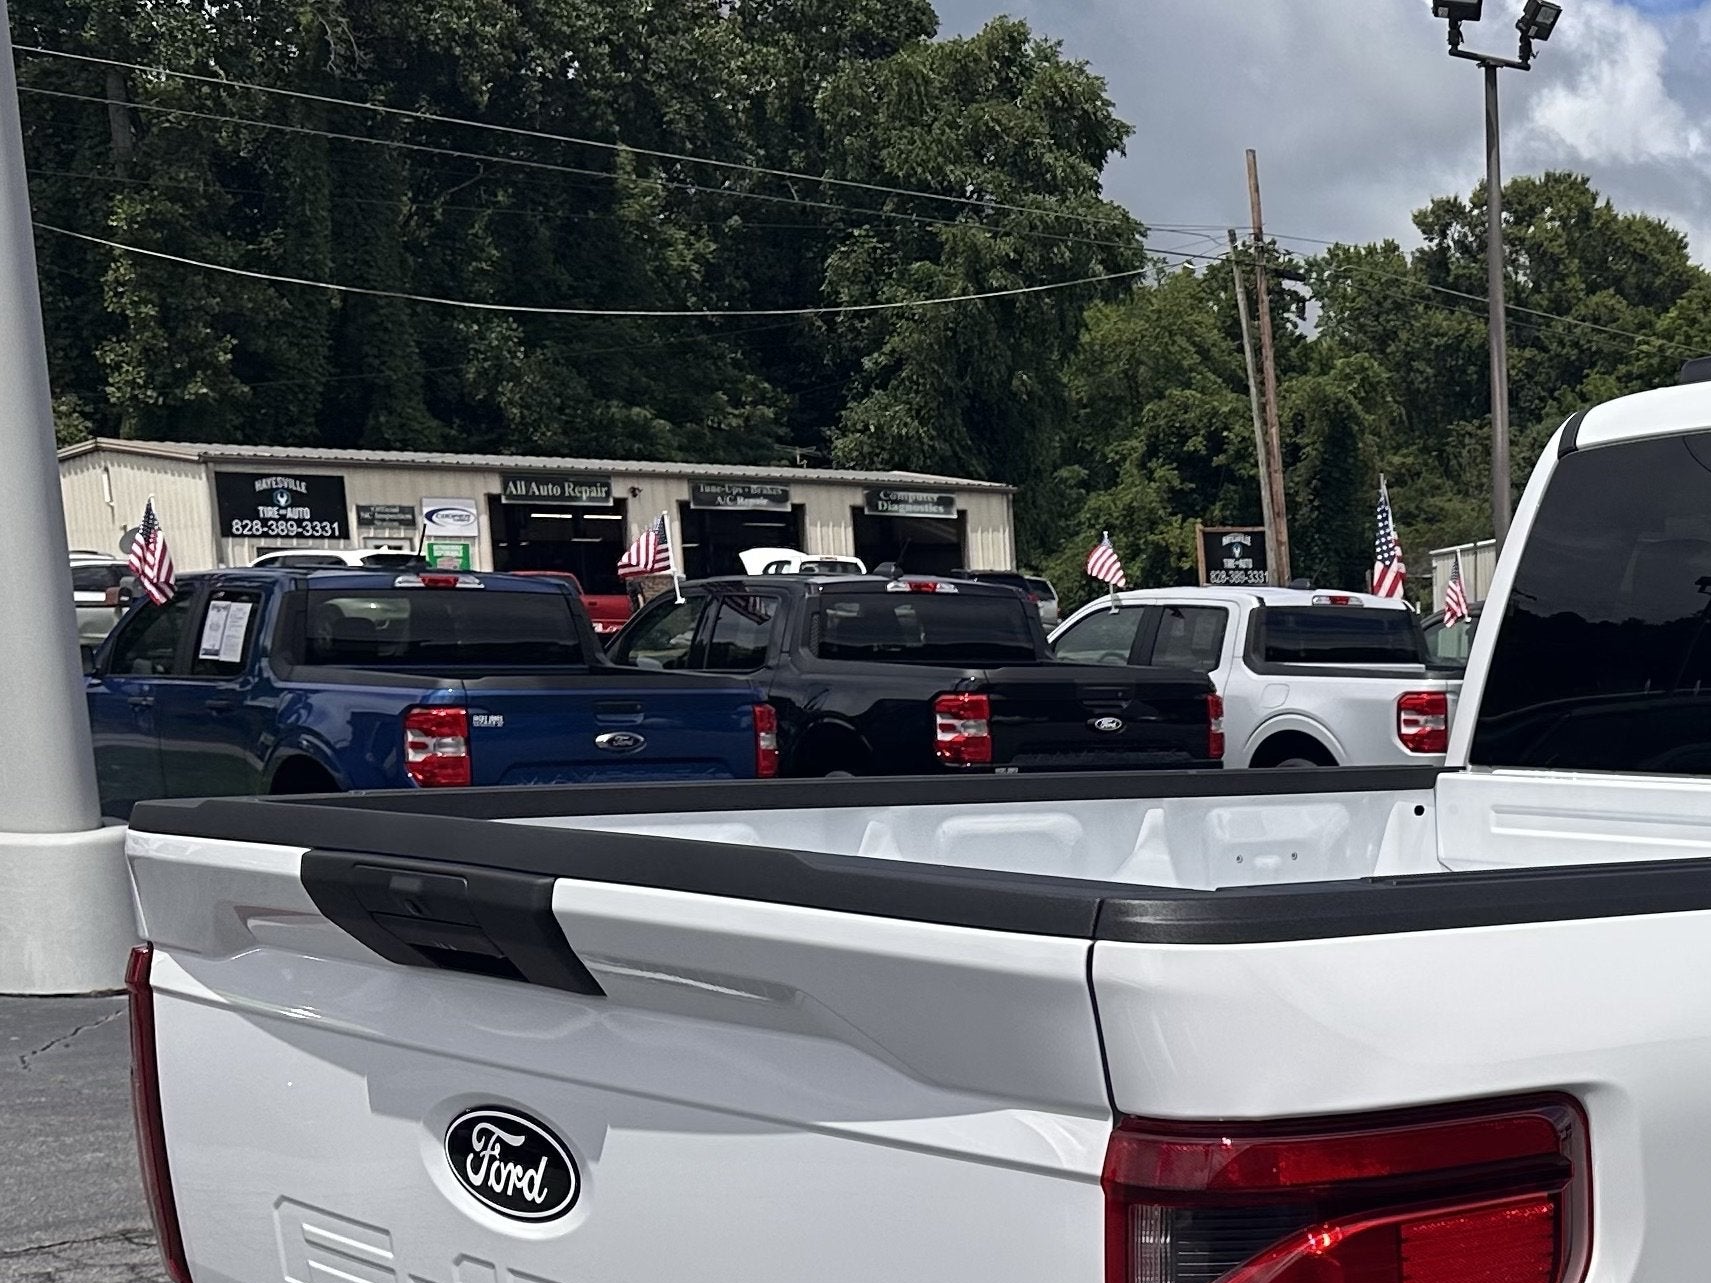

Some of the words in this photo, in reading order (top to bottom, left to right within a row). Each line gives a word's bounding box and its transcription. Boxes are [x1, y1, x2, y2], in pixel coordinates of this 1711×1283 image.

[254, 476, 307, 494] HAYESVILLE
[505, 480, 526, 495] All
[528, 481, 561, 496] Auto
[564, 482, 608, 501] Repair
[258, 506, 279, 519] TIRE
[286, 507, 310, 519] AUTO
[232, 519, 340, 537] 828-389-3331
[466, 1122, 548, 1204] Ford
